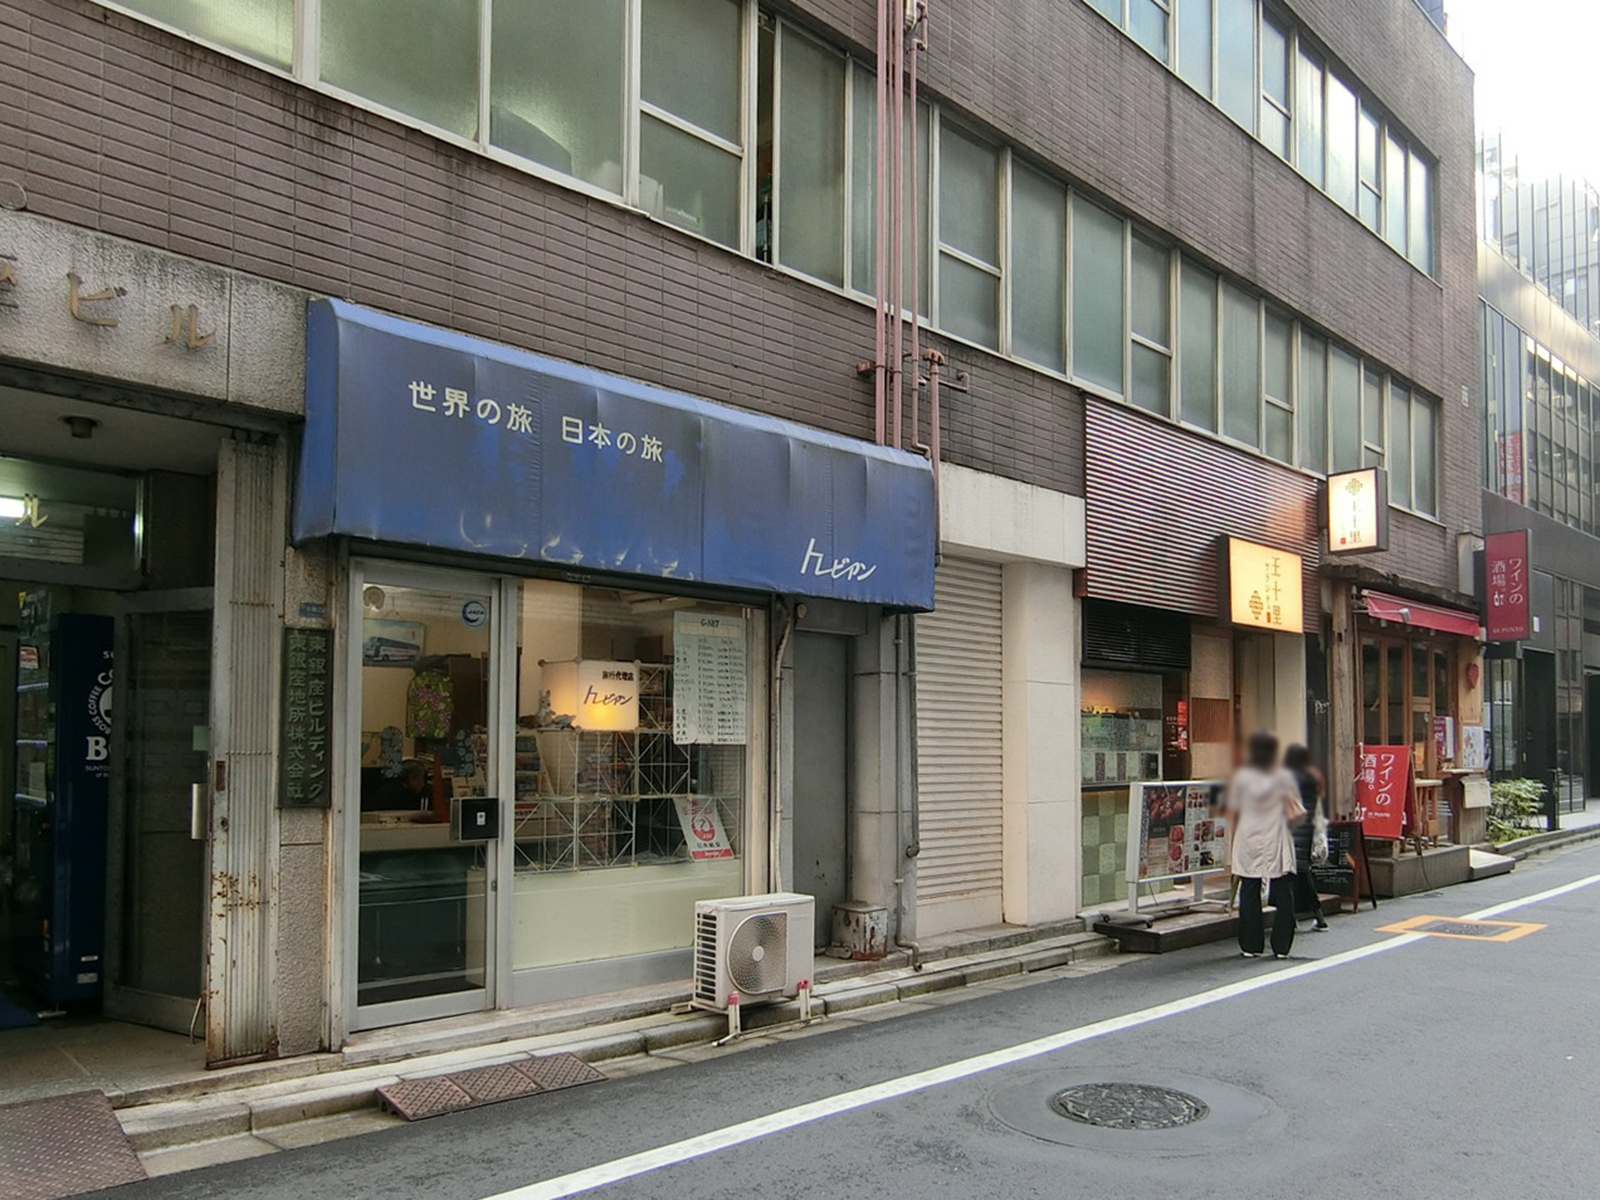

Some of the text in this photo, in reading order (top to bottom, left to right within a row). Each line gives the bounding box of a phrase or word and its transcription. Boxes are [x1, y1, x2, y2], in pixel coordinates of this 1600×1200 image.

[408, 380, 663, 463] 世界の旅 日本の旅
[800, 537, 877, 581] トレビアン
[1508, 558, 1523, 605] ワインの
[286, 633, 307, 798] 東銀座地所株式会社
[308, 635, 326, 799] 東銀座ビルディング
[583, 685, 633, 706] トレビアン
[1375, 753, 1395, 806] ワインの
